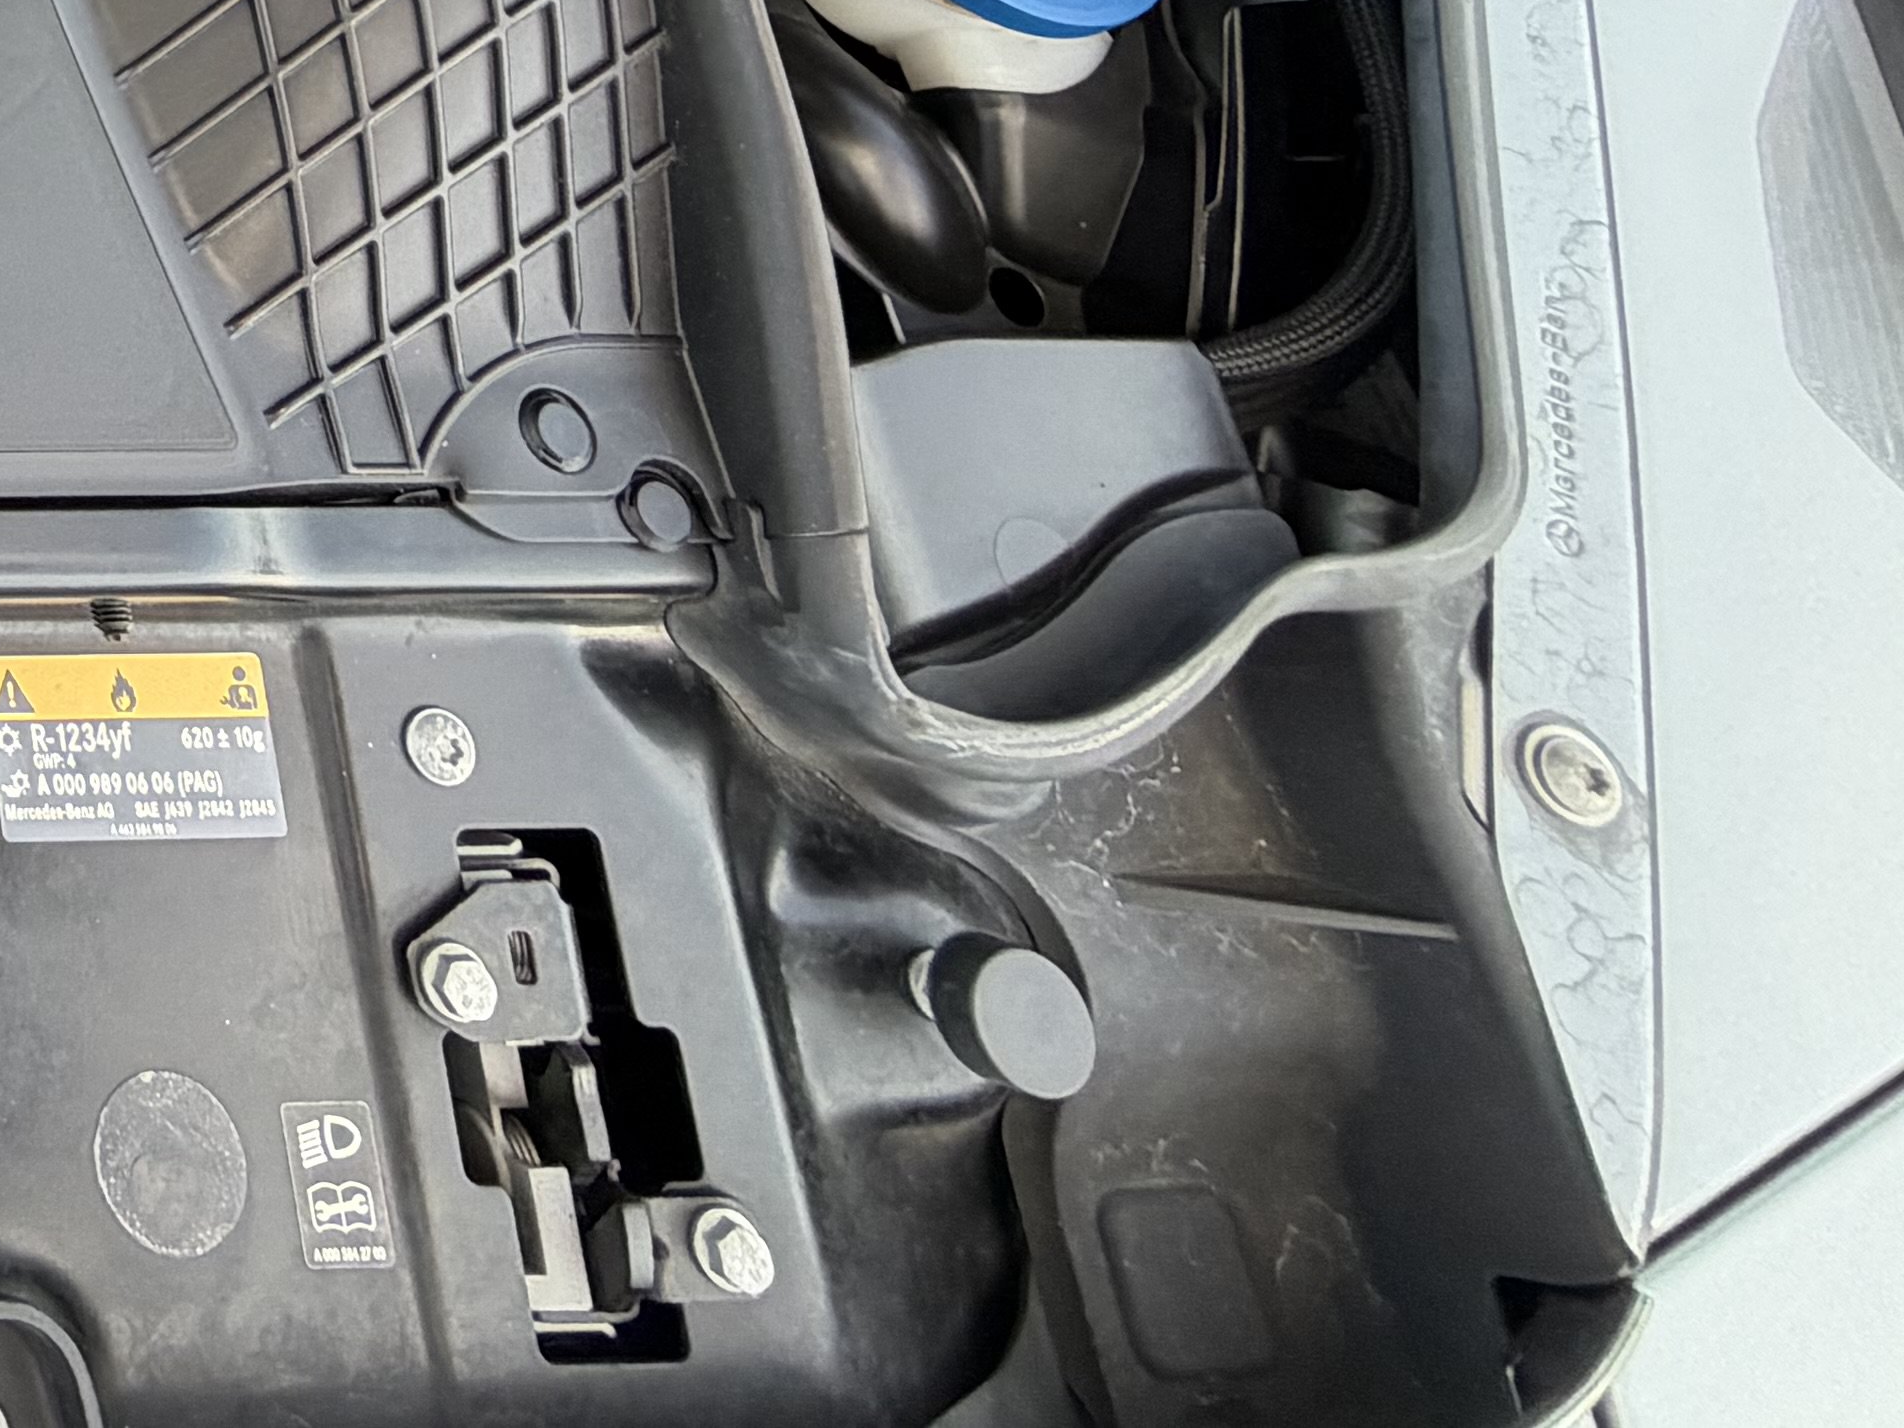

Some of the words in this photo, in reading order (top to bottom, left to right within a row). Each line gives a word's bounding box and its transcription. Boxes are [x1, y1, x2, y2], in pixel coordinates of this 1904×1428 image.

[30, 721, 132, 760] R-1234yf
[181, 726, 213, 749] 620
[234, 726, 266, 753] 10g
[33, 753, 65, 770] GWP:
[67, 755, 77, 769] 4
[37, 775, 51, 796] A
[52, 773, 86, 795] 000
[89, 773, 122, 795] 989
[126, 772, 147, 794] 06
[151, 771, 174, 794] 06
[177, 770, 223, 797] (PAG)
[5, 801, 95, 821] Mercedes-Benz
[96, 801, 115, 820] AG
[135, 801, 159, 819] SAE
